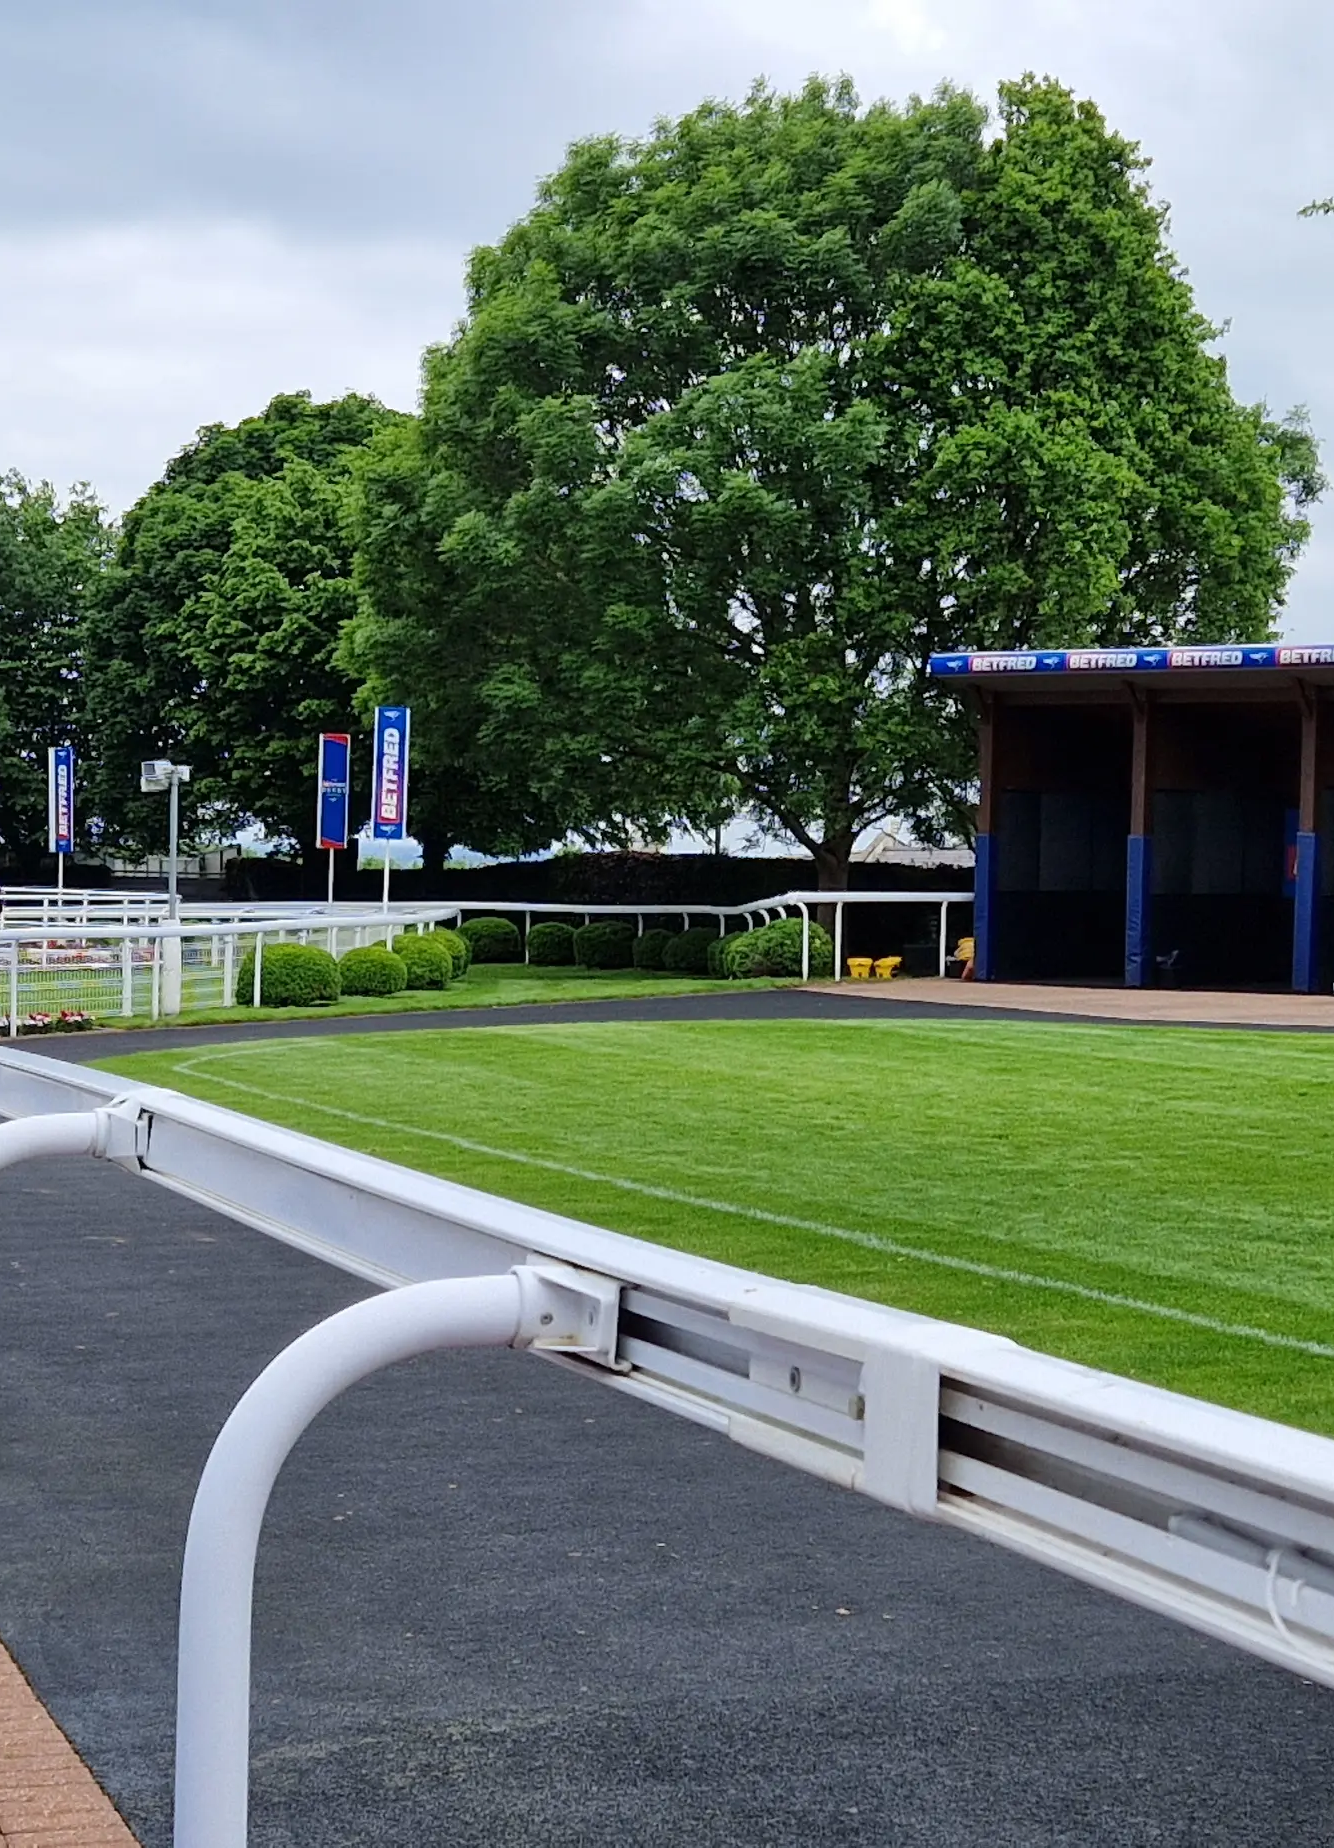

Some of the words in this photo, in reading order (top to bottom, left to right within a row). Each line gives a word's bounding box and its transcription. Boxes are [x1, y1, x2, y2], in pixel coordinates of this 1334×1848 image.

[971, 656, 1037, 672] BETFRED
[1069, 653, 1137, 669] BETFRED
[1171, 651, 1243, 667] BETFRED
[380, 727, 400, 819] BETFRED
[57, 764, 68, 835] BETFRED
